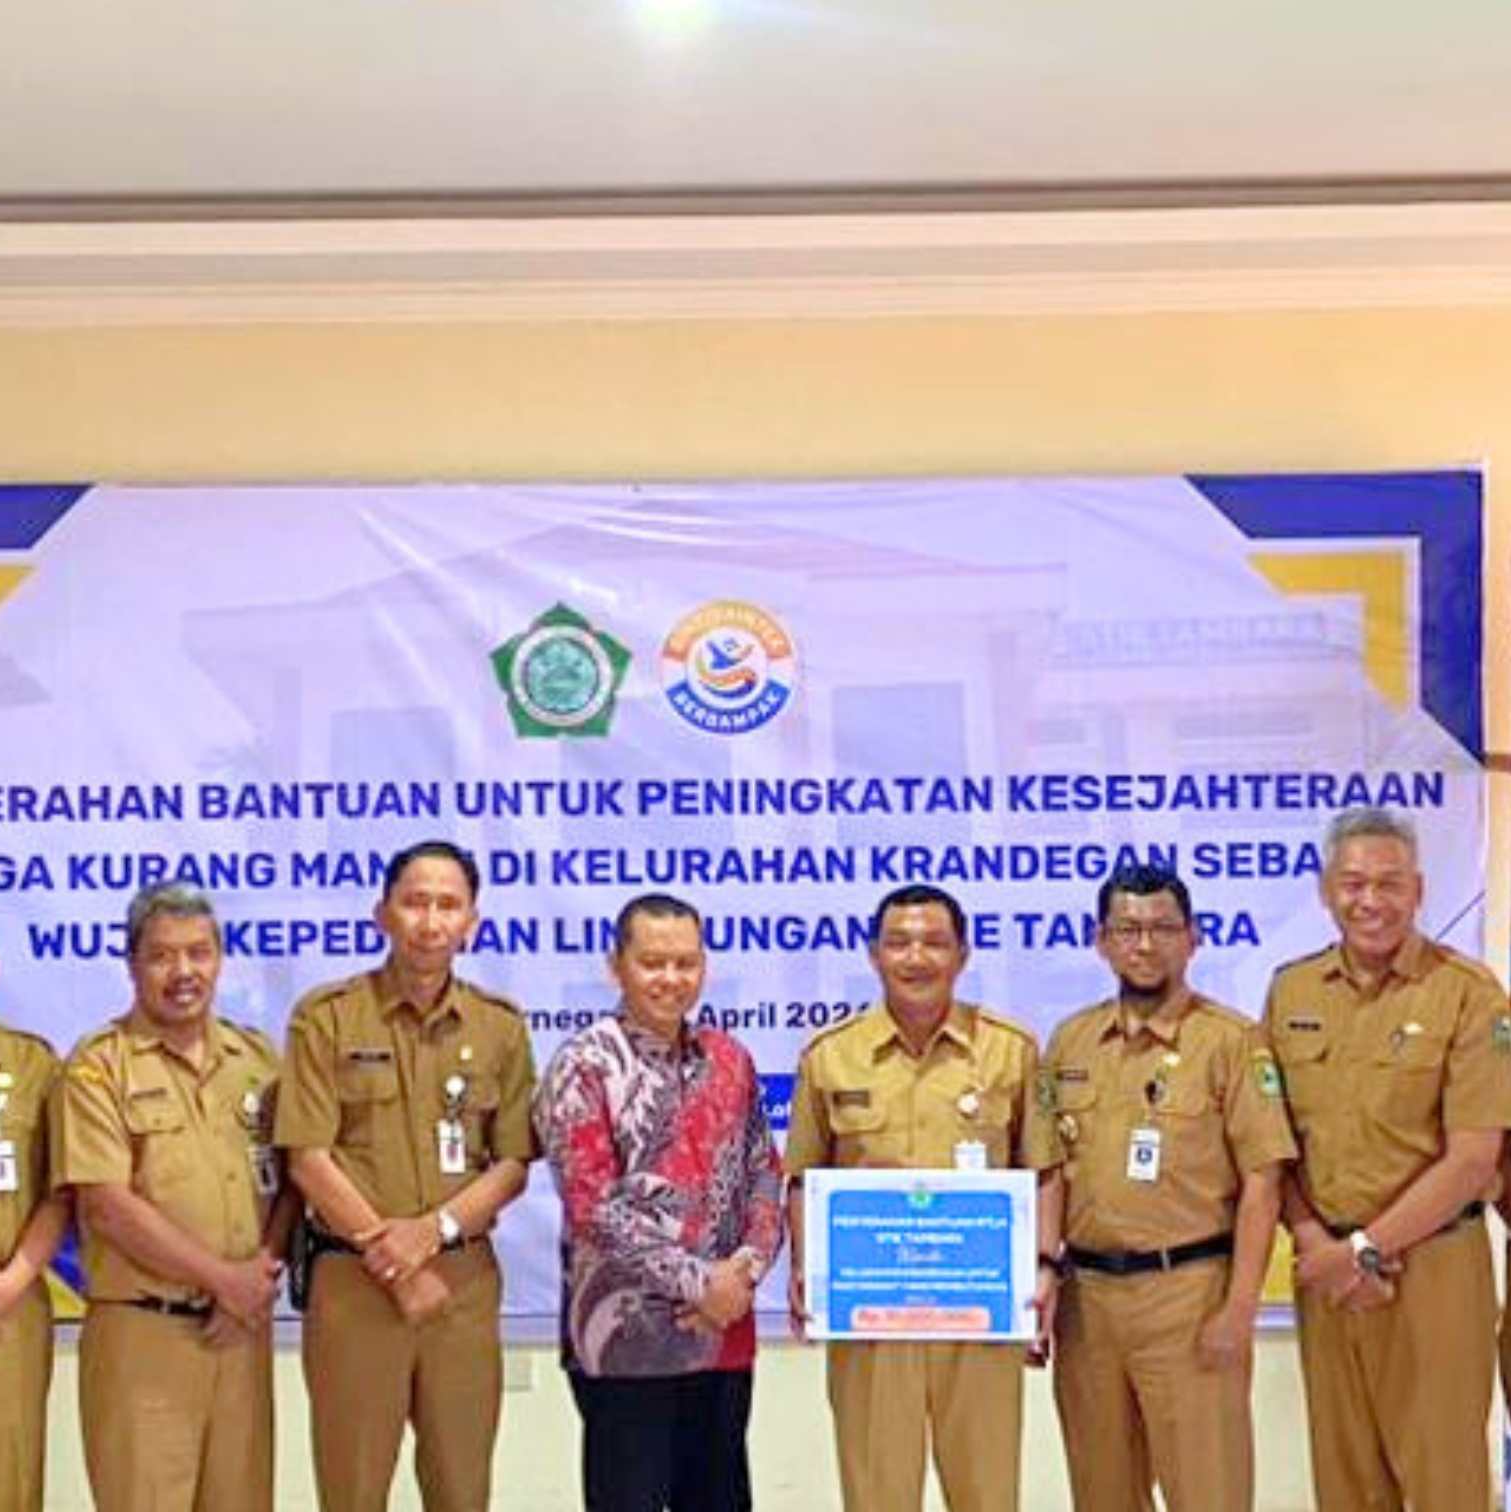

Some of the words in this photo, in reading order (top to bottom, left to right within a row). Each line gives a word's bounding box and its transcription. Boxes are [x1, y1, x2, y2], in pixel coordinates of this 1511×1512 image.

[199, 782, 440, 820] BANTUAN
[457, 780, 624, 818] UNTUK
[637, 776, 993, 815] PENINGKATAN
[1009, 771, 1444, 811] KESEJAHTERAAN
[69, 853, 276, 890] KURANG
[493, 849, 536, 885] DI
[553, 846, 855, 886] KELURAHAN
[872, 843, 1176, 881] KRANDEGAN
[698, 1001, 776, 1032] April
